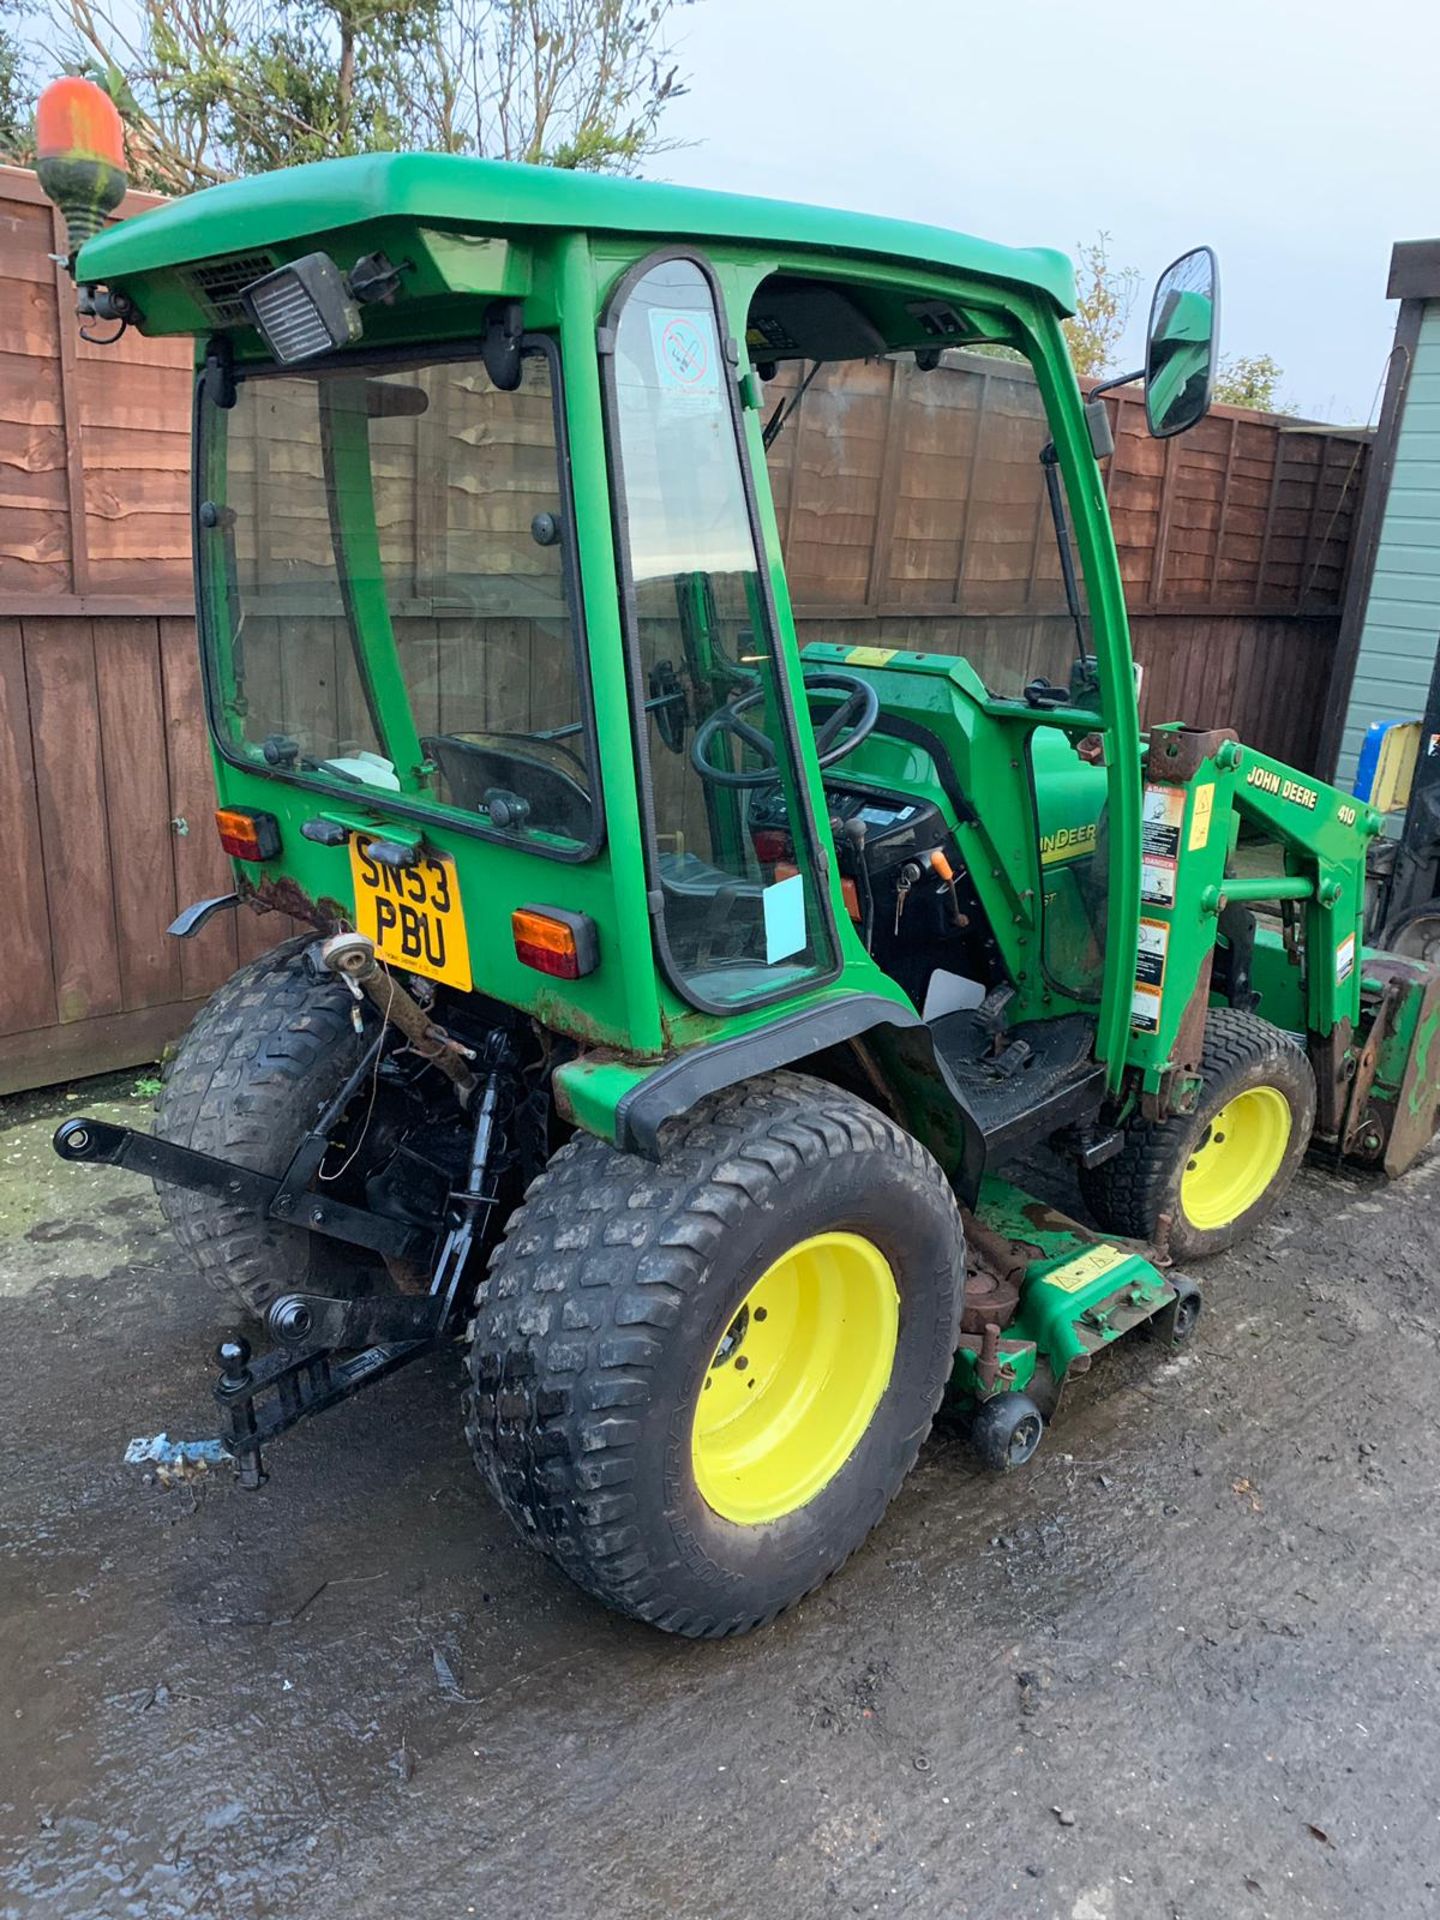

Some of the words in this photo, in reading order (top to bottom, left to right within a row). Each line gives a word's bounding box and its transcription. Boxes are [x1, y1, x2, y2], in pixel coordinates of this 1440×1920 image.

[1247, 766, 1281, 795] JOHN
[1282, 779, 1319, 811] DEERE
[1337, 804, 1356, 826] 410
[356, 835, 450, 914] SN53
[375, 895, 446, 968] PBU
